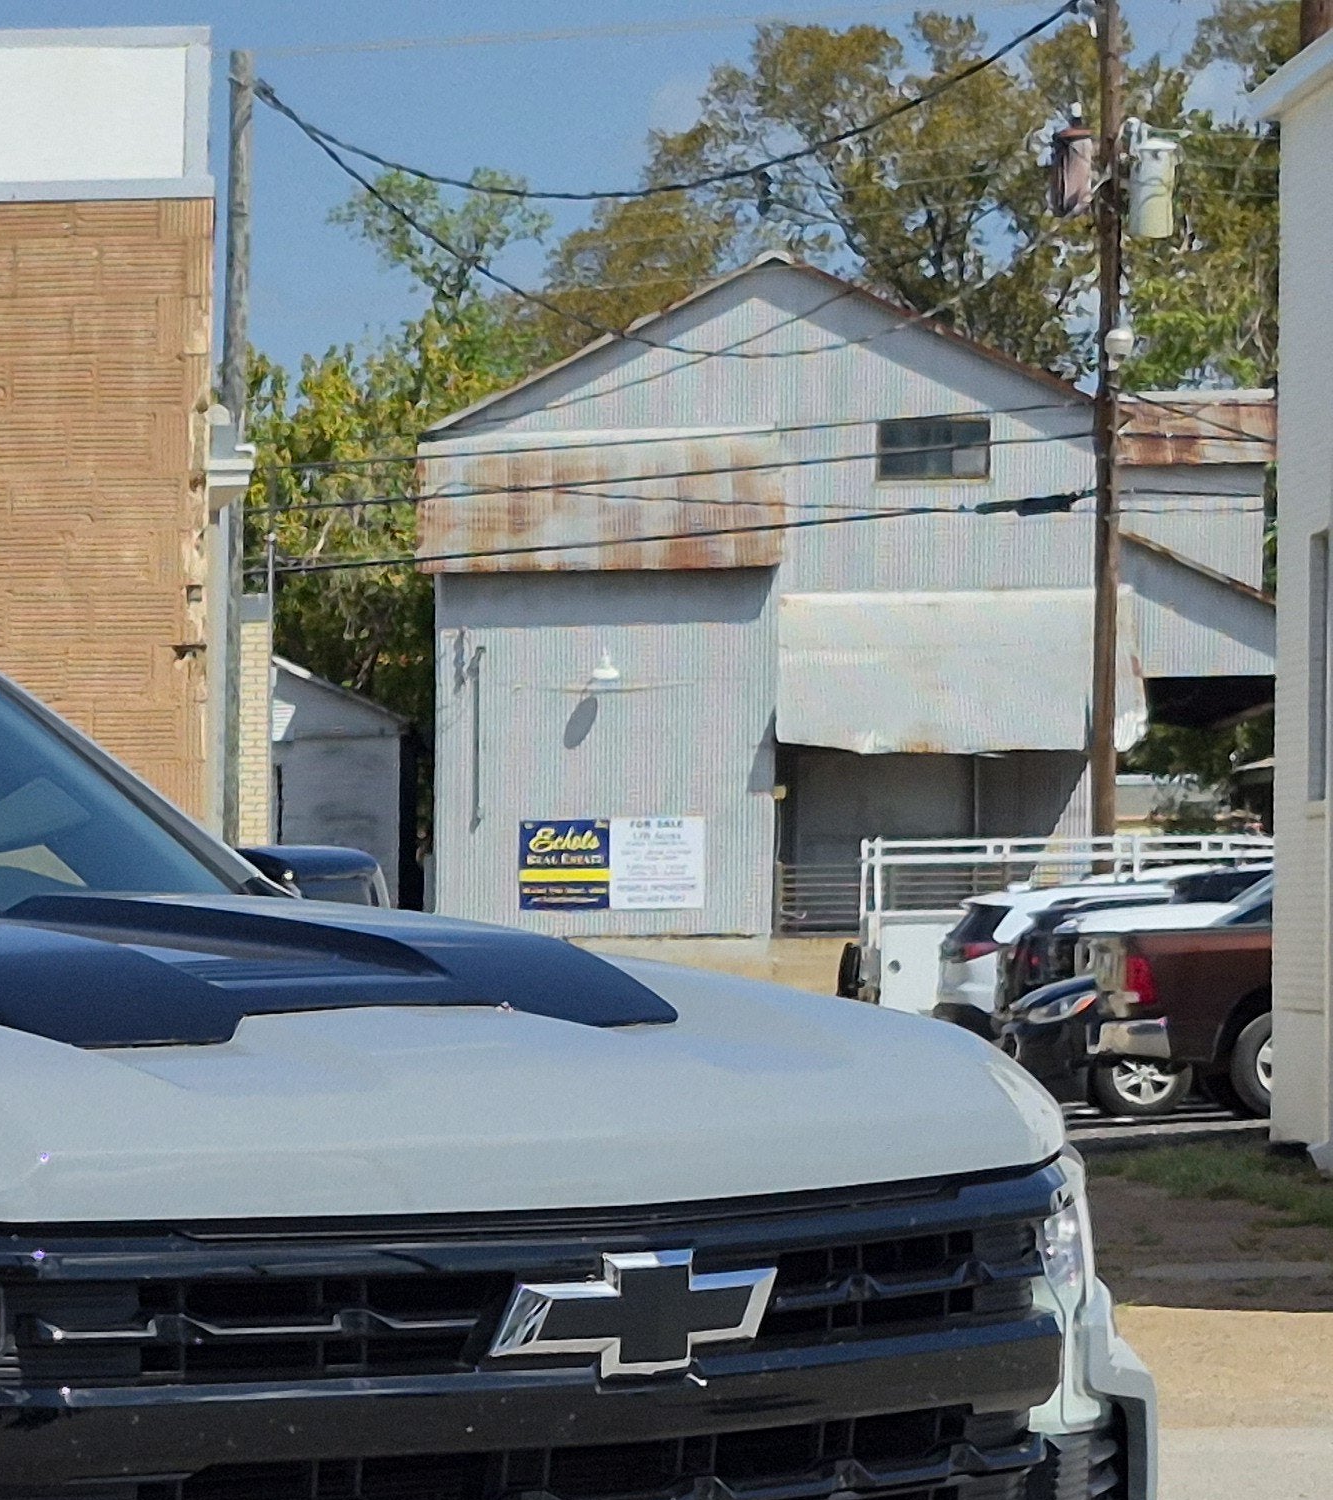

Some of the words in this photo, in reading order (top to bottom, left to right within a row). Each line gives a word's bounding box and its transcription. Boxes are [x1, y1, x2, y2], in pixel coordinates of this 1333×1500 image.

[629, 820, 652, 829] FOR
[657, 820, 684, 829] SALE
[529, 826, 600, 853] Echols
[527, 854, 558, 865] REAL
